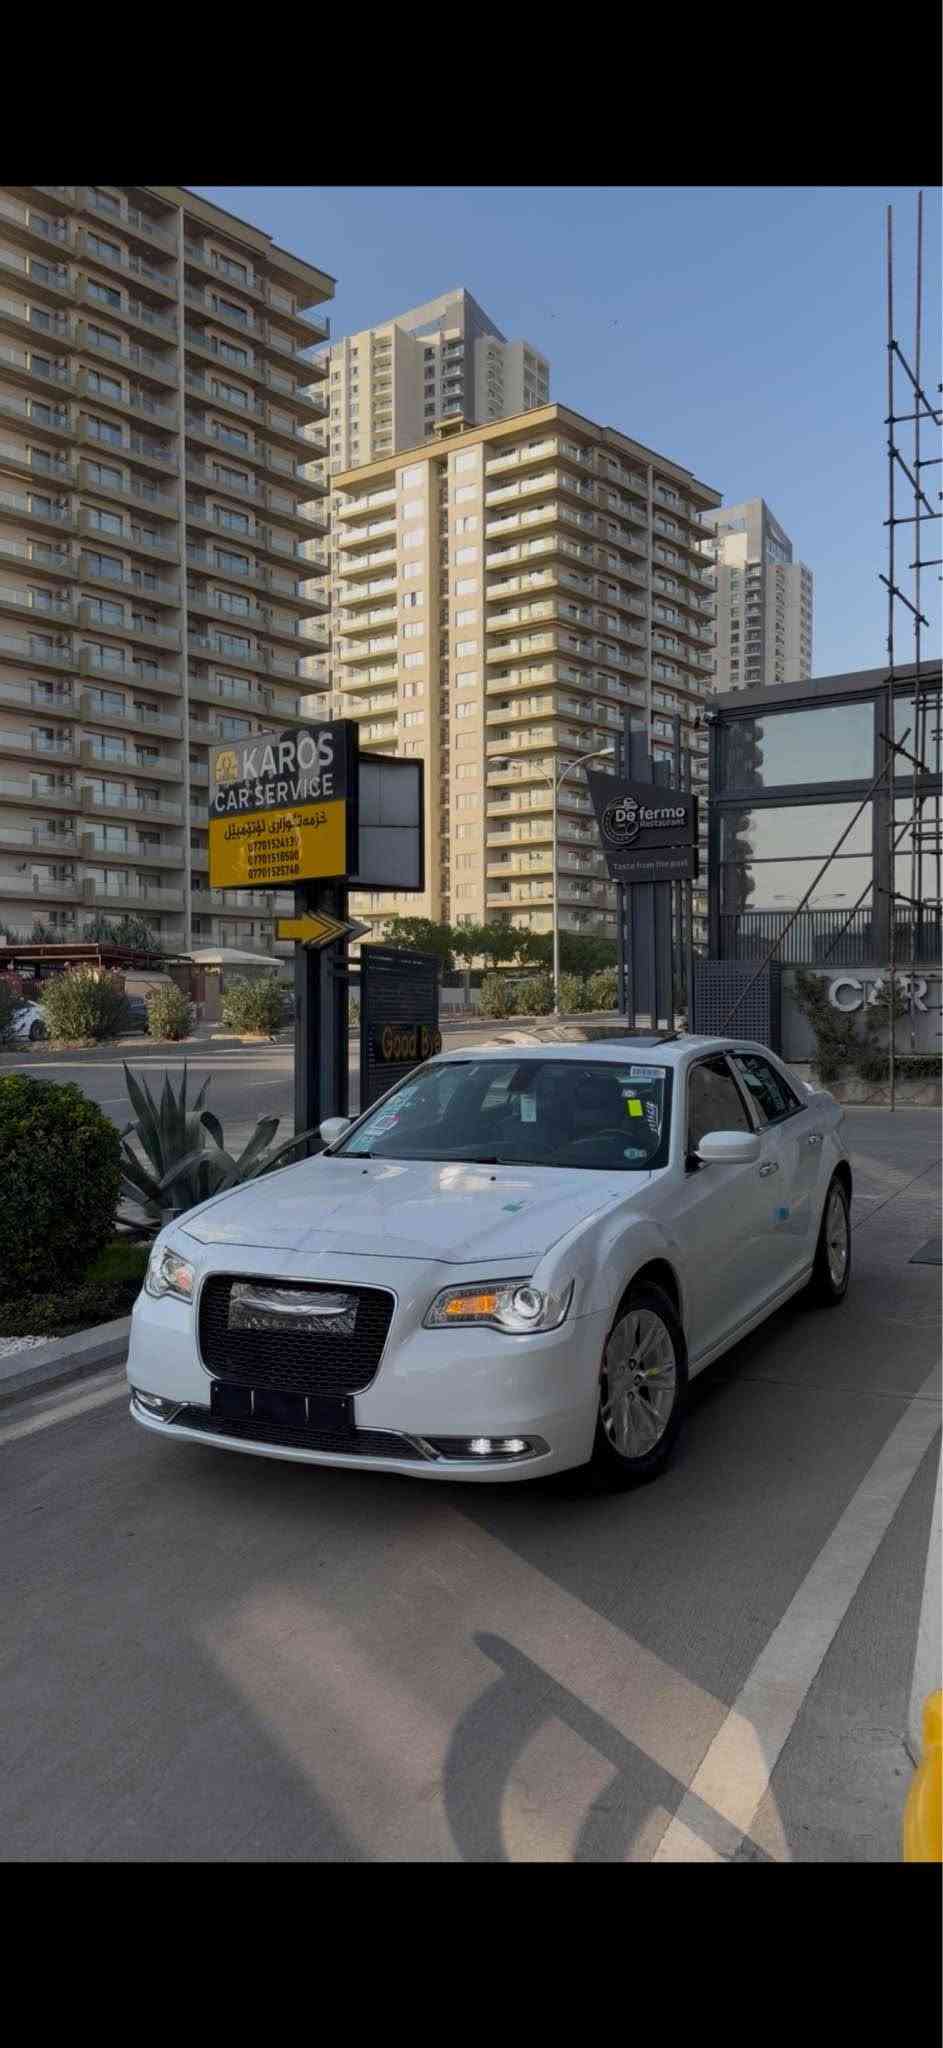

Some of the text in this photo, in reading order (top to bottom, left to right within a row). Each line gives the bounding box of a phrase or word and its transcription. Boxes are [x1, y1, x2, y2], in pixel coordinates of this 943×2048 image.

[242, 730, 334, 779] KAROS
[215, 773, 334, 812] CAR SERVICE
[639, 806, 685, 820] fermo
[382, 1024, 417, 1058] Good
